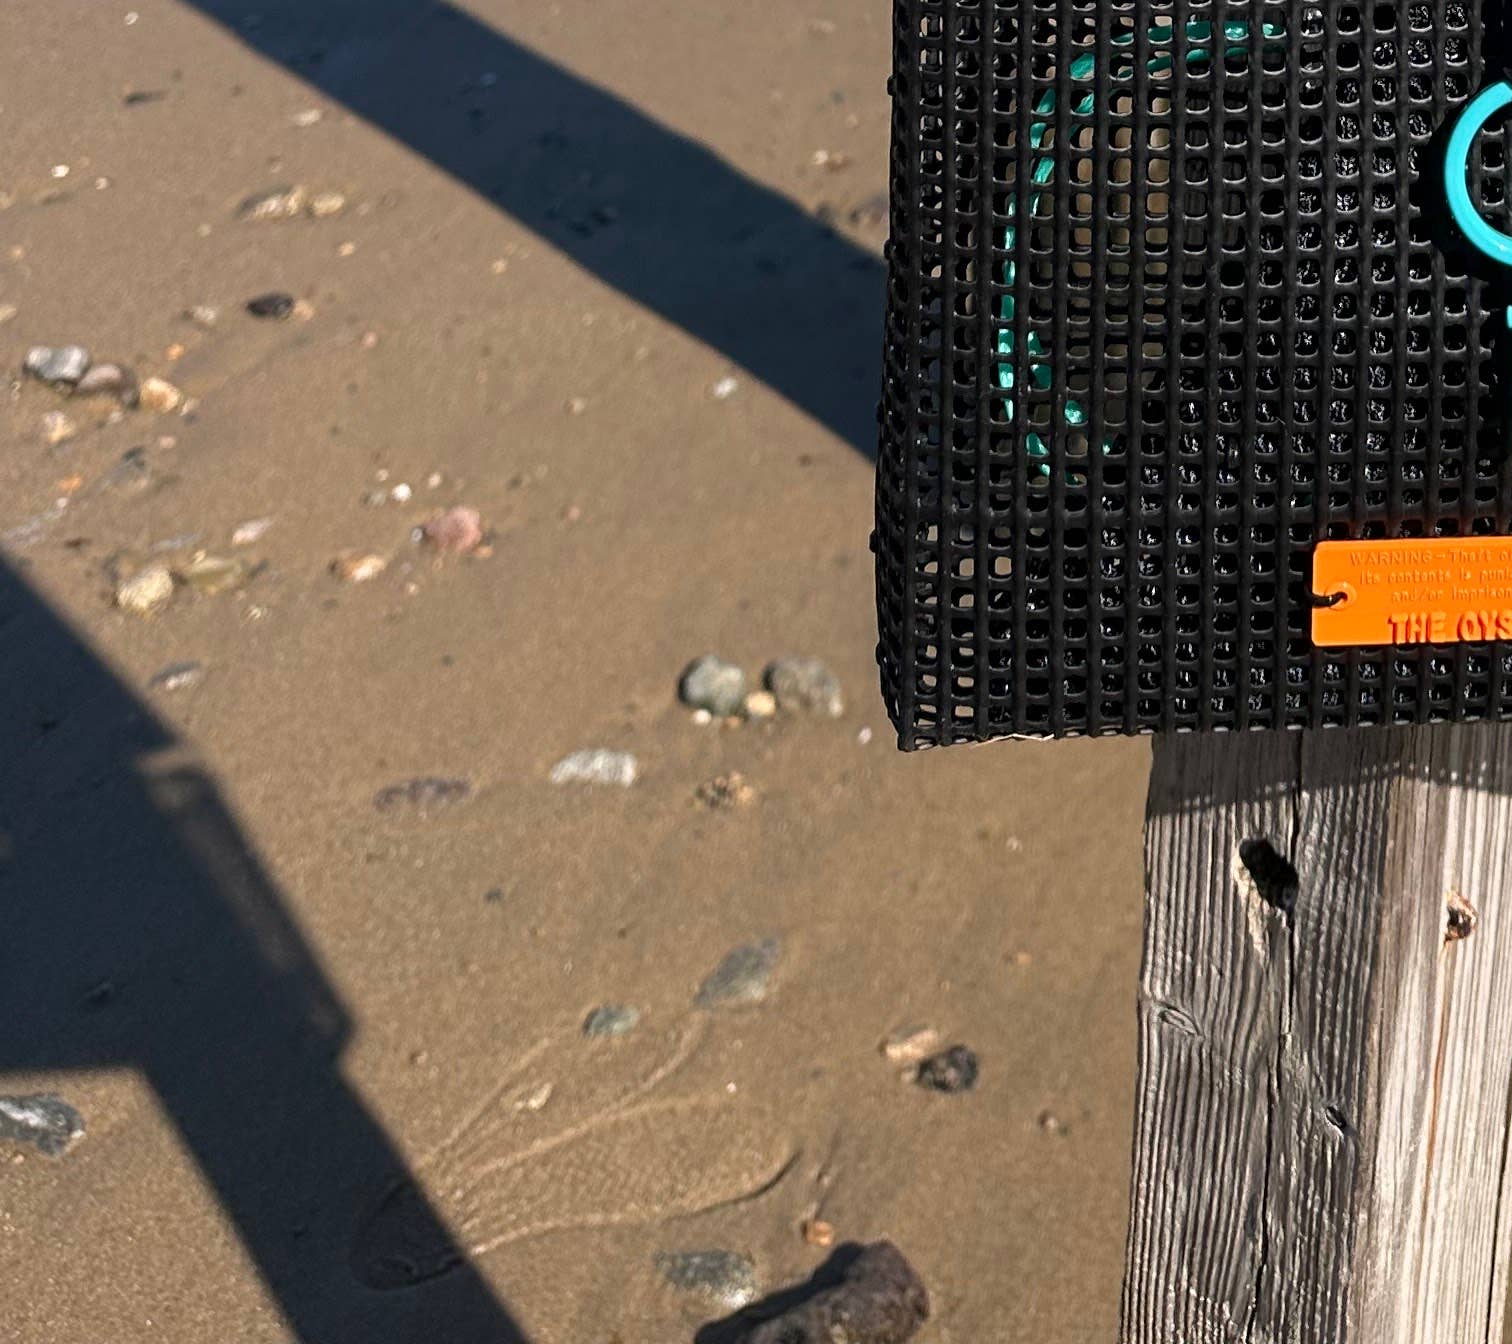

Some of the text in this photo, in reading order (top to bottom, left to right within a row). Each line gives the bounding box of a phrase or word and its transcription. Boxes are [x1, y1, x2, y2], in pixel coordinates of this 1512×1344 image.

[1387, 568, 1451, 584] contents
[1459, 566, 1472, 581] is
[1392, 587, 1444, 603] and/or
[1387, 611, 1447, 644] THE
